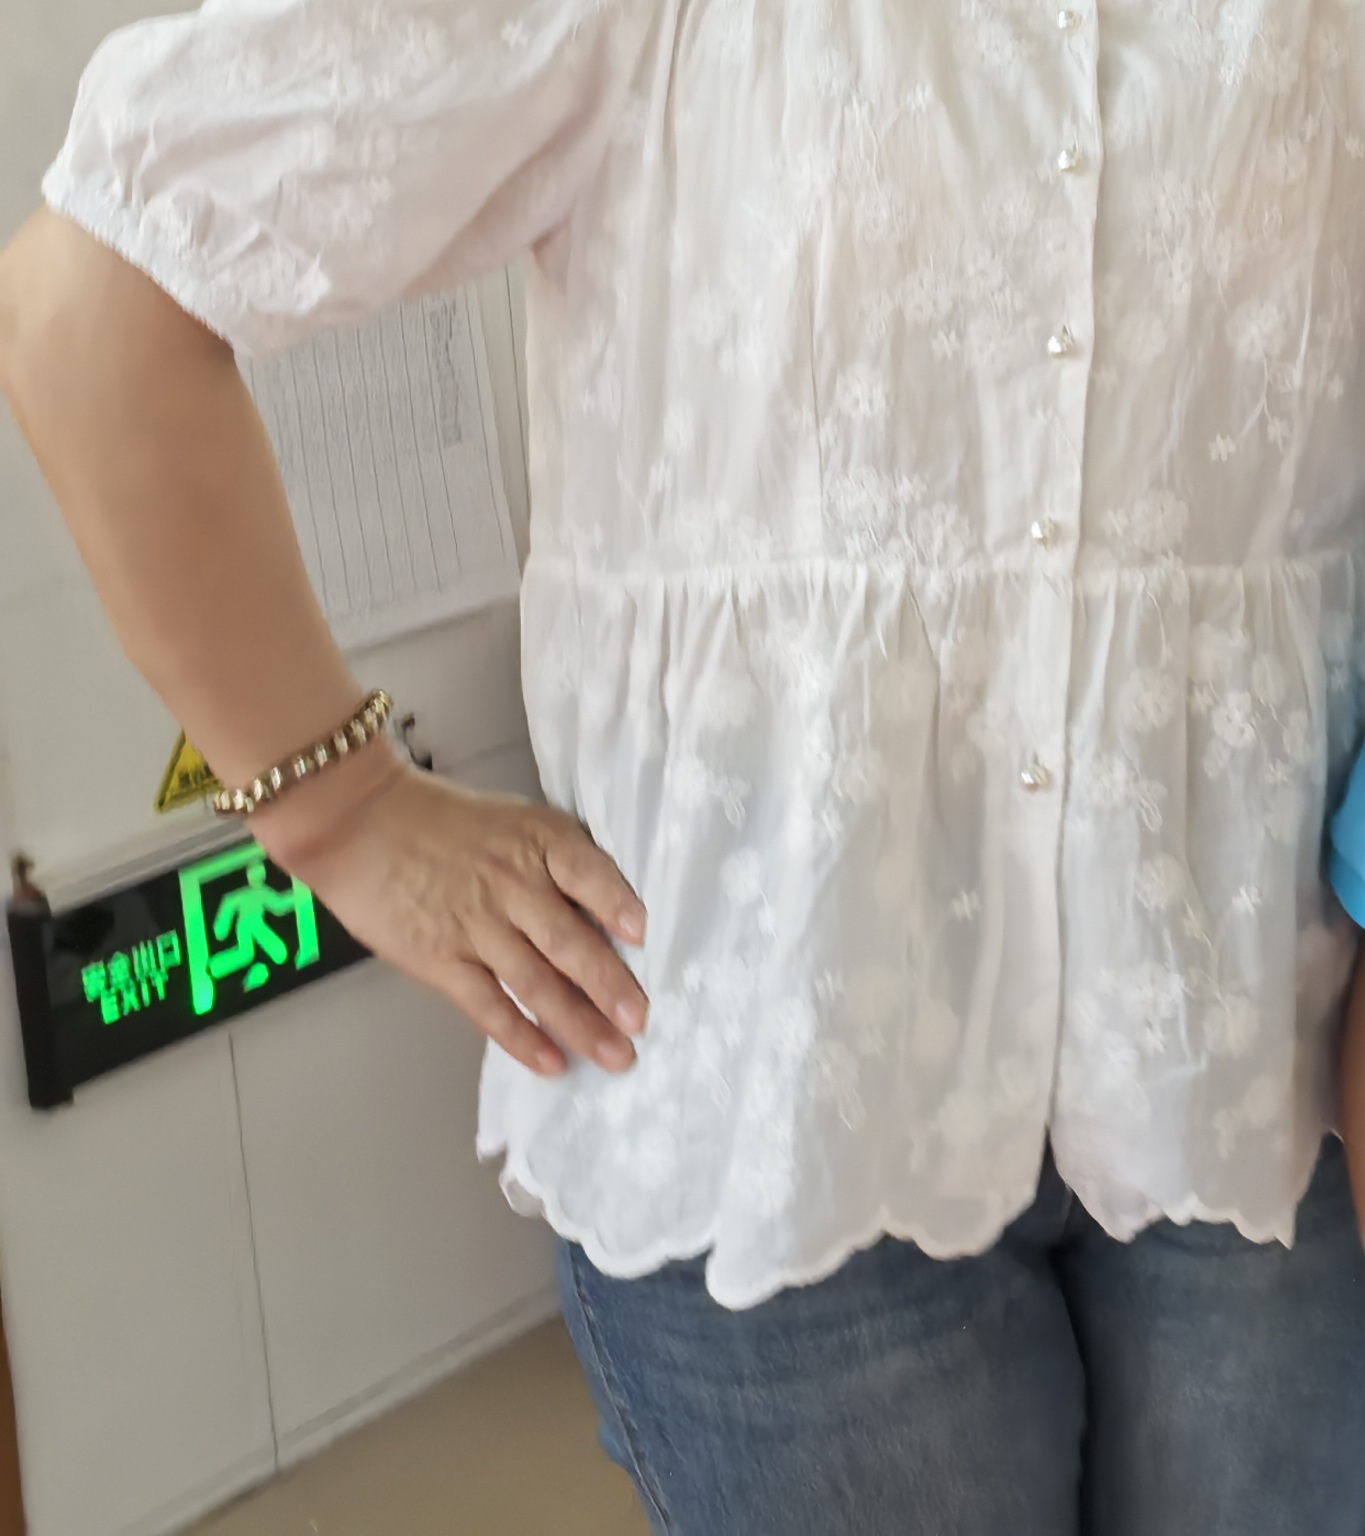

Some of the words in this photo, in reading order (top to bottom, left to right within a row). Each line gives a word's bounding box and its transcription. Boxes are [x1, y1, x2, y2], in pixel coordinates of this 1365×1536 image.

[81, 928, 181, 1003] 安全出口
[100, 968, 168, 1024] EXIT
